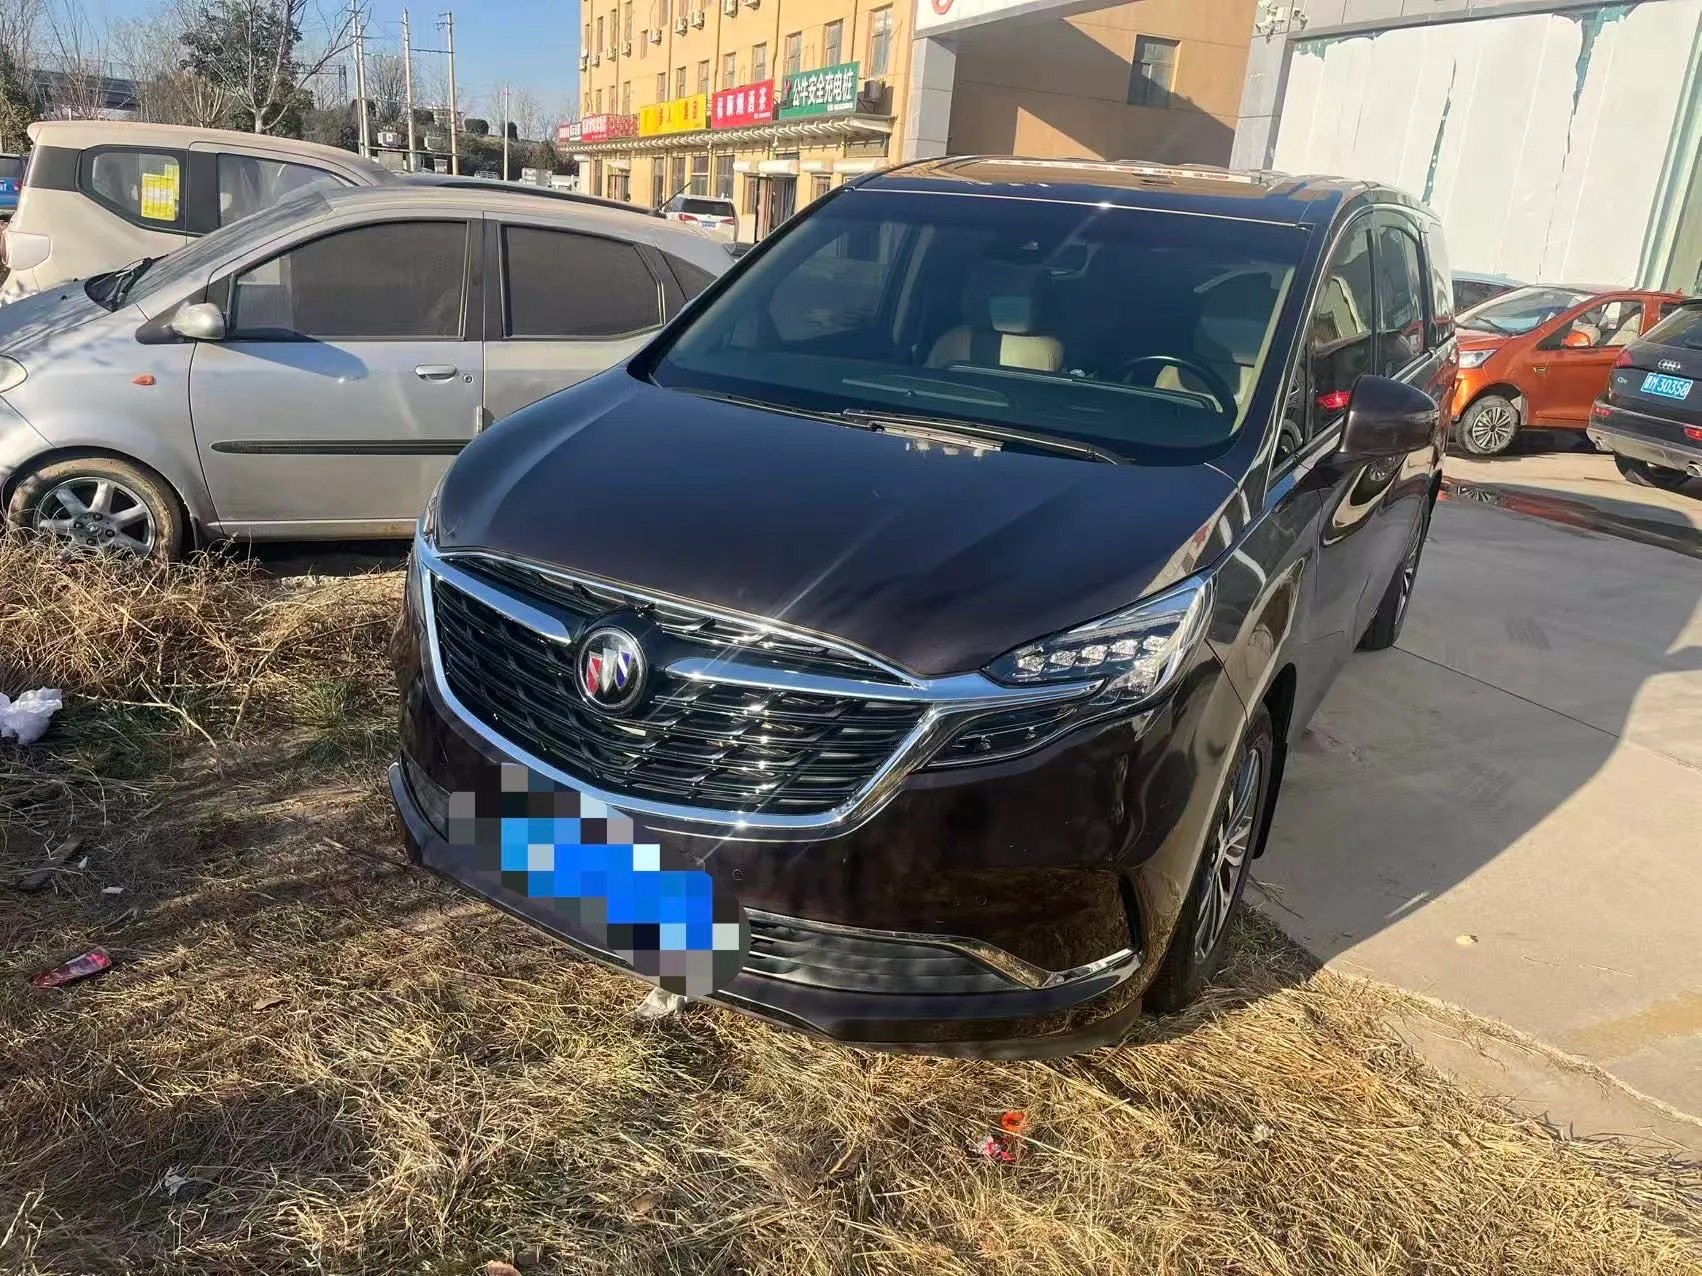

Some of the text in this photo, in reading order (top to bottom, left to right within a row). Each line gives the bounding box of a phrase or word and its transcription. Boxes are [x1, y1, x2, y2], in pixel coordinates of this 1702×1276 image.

[792, 68, 854, 107] 公牛安全充电桩
